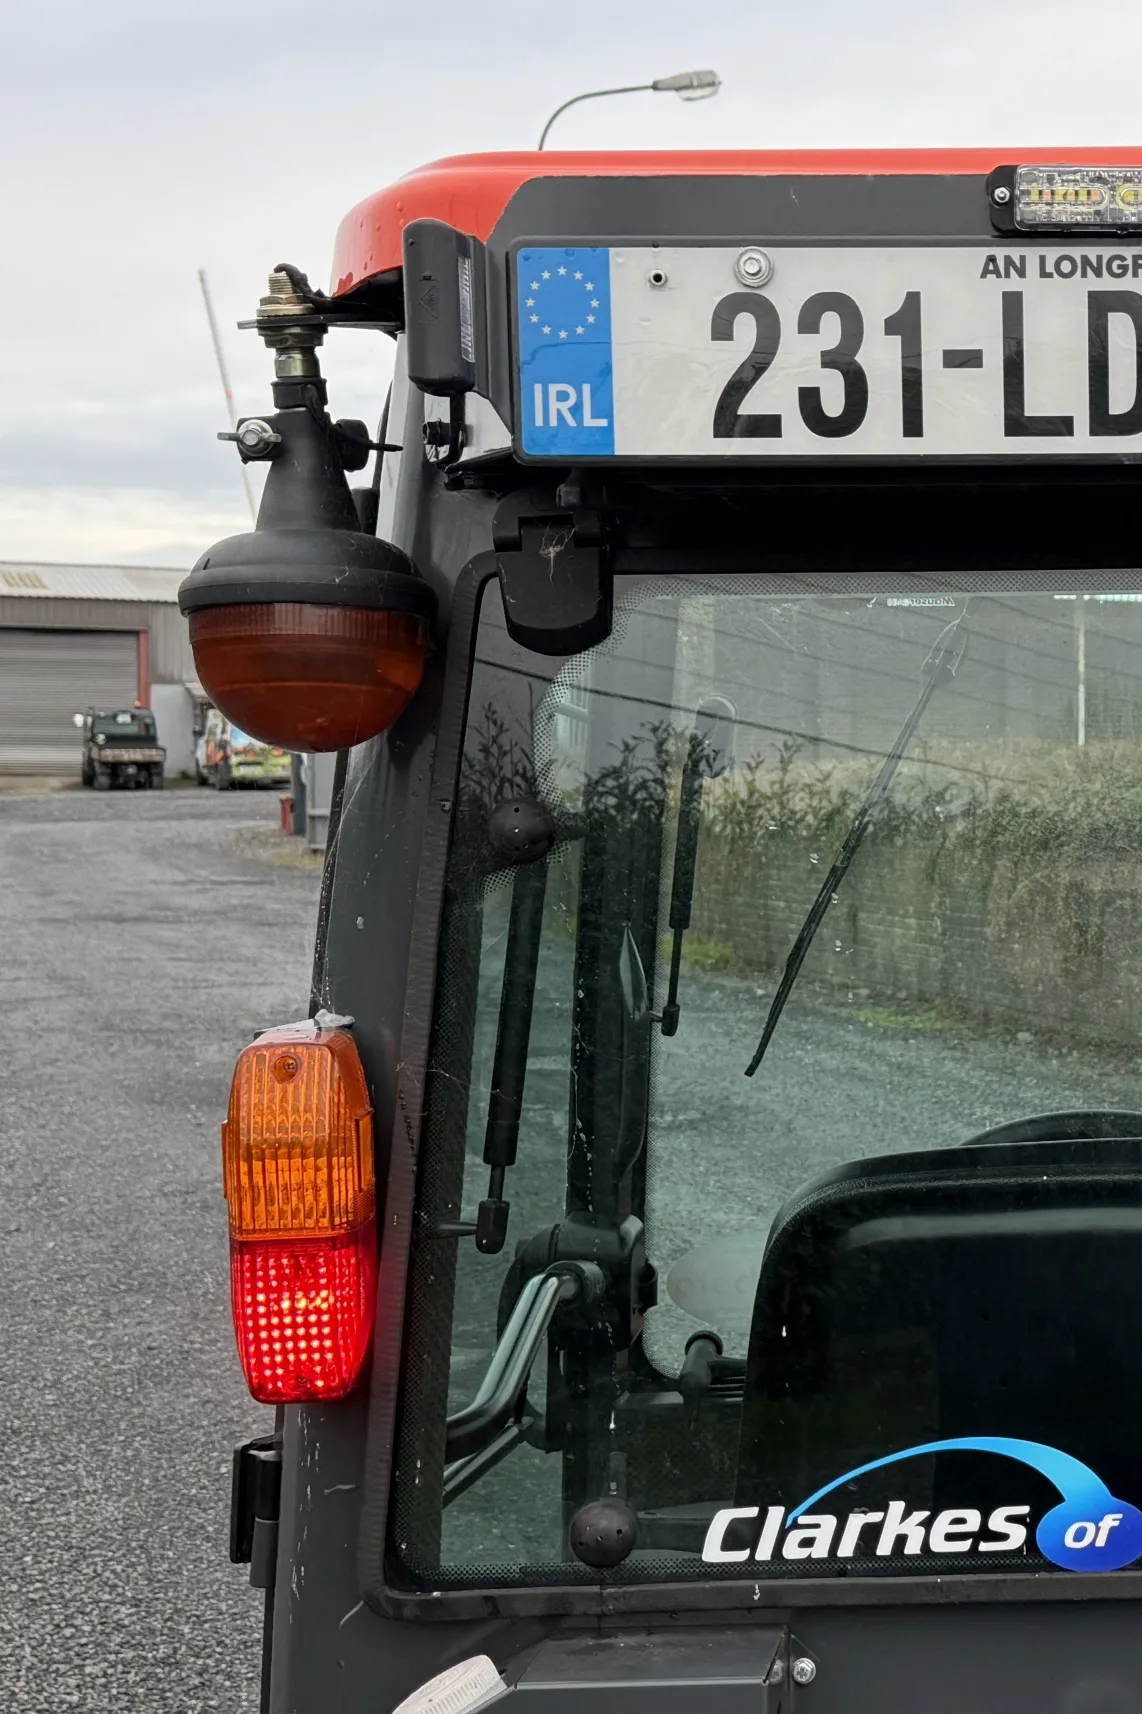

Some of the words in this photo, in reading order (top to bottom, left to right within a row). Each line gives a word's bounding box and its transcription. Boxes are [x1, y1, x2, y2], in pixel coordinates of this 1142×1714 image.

[979, 254, 1027, 279] AN
[533, 382, 609, 428] IRL
[701, 1499, 1032, 1564] Clarkes
[1063, 1513, 1123, 1550] of
